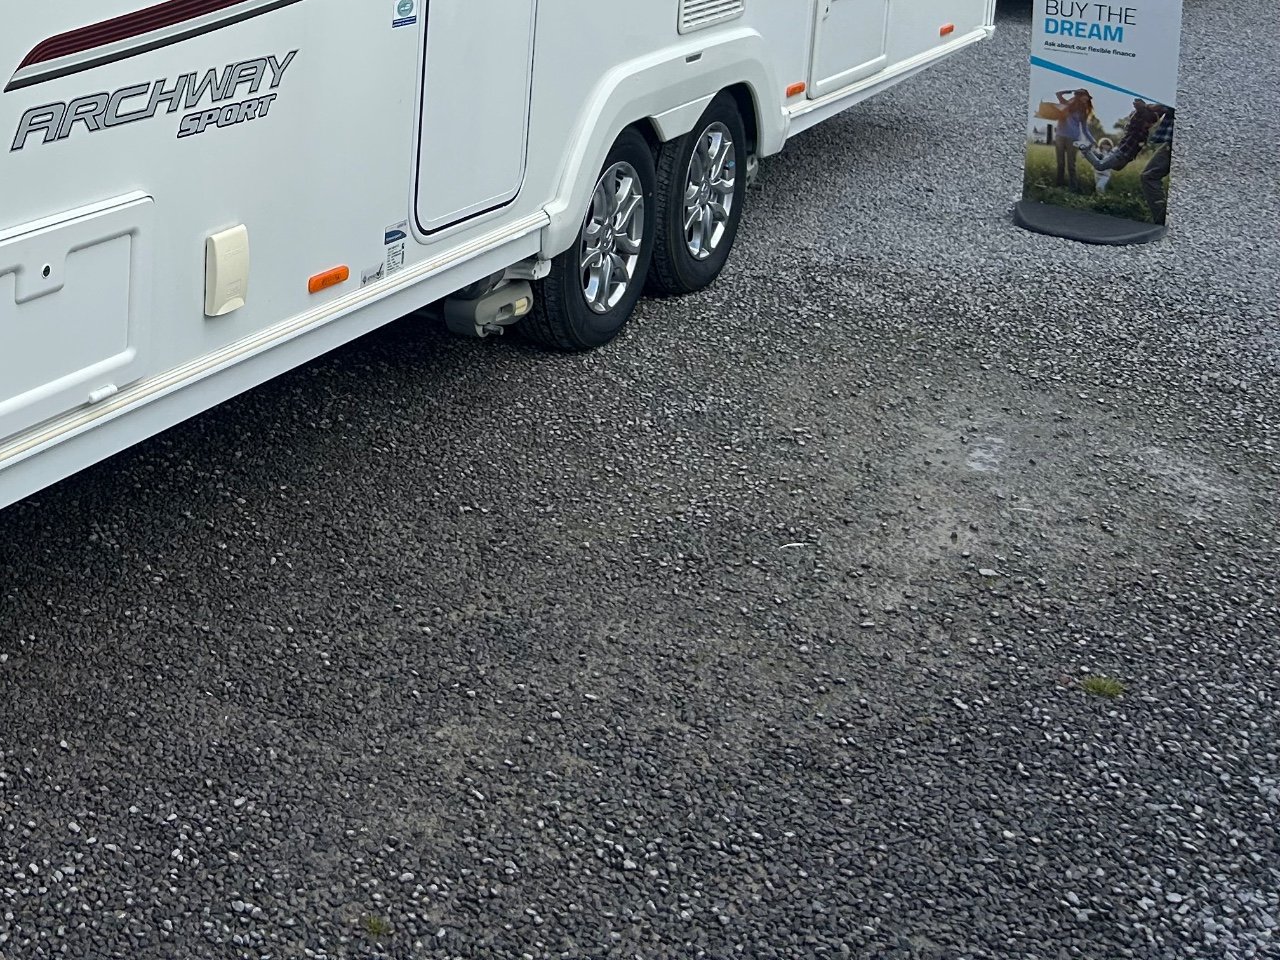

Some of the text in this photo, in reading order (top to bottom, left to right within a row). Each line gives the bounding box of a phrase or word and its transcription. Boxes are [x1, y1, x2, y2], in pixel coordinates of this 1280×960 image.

[1093, 3, 1137, 26] THE
[1044, 17, 1124, 43] DREAM
[1056, 42, 1076, 50] about
[1088, 45, 1112, 55] flexible
[1112, 49, 1136, 58] finance
[9, 48, 300, 153] ARCHWAY
[176, 92, 277, 139] SPORT
